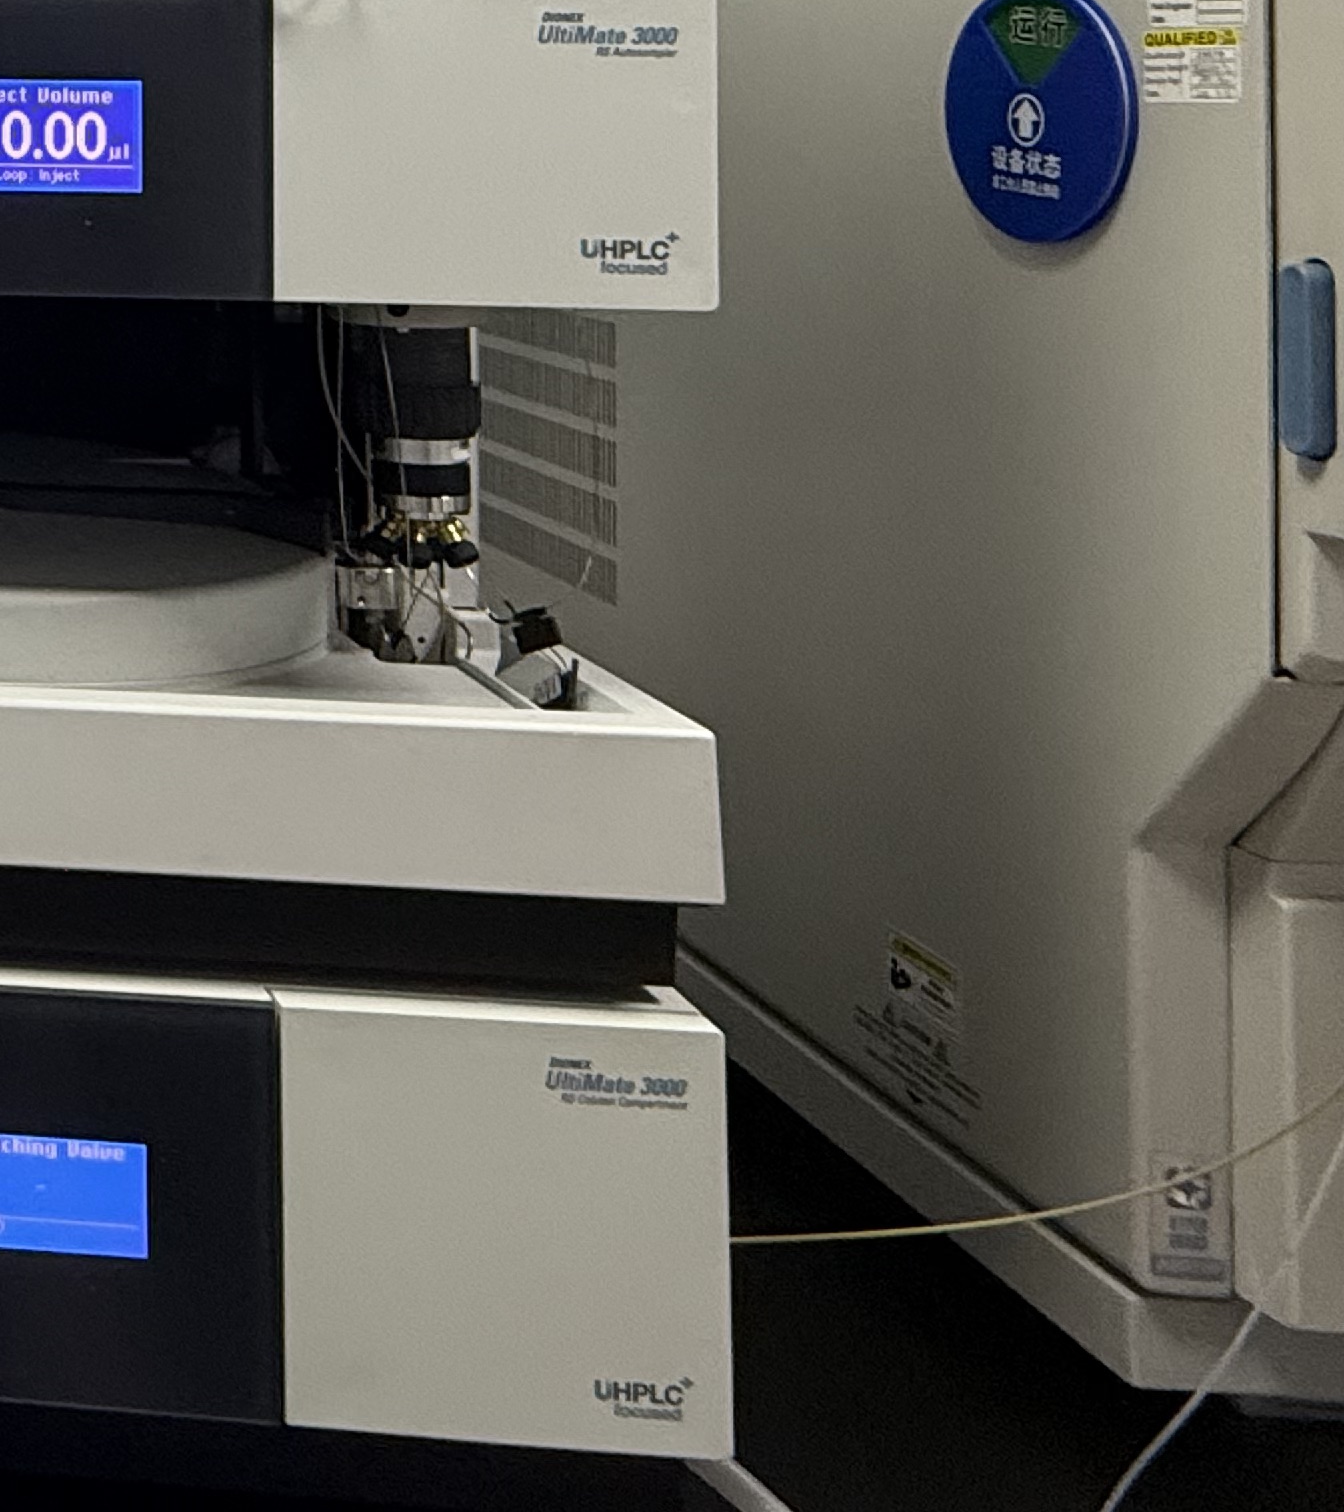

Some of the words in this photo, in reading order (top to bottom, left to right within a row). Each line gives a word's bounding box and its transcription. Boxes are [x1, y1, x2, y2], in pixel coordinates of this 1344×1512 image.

[538, 25, 627, 44] UltiMate
[631, 26, 678, 45] 3000
[1011, 6, 1067, 48] 运行
[1144, 31, 1217, 46] QUALIFIED
[37, 88, 113, 104] Volume
[992, 145, 1062, 179] 设备状态
[39, 169, 80, 183] Inject
[600, 261, 667, 274] focused
[67, 1143, 126, 1162] Valve
